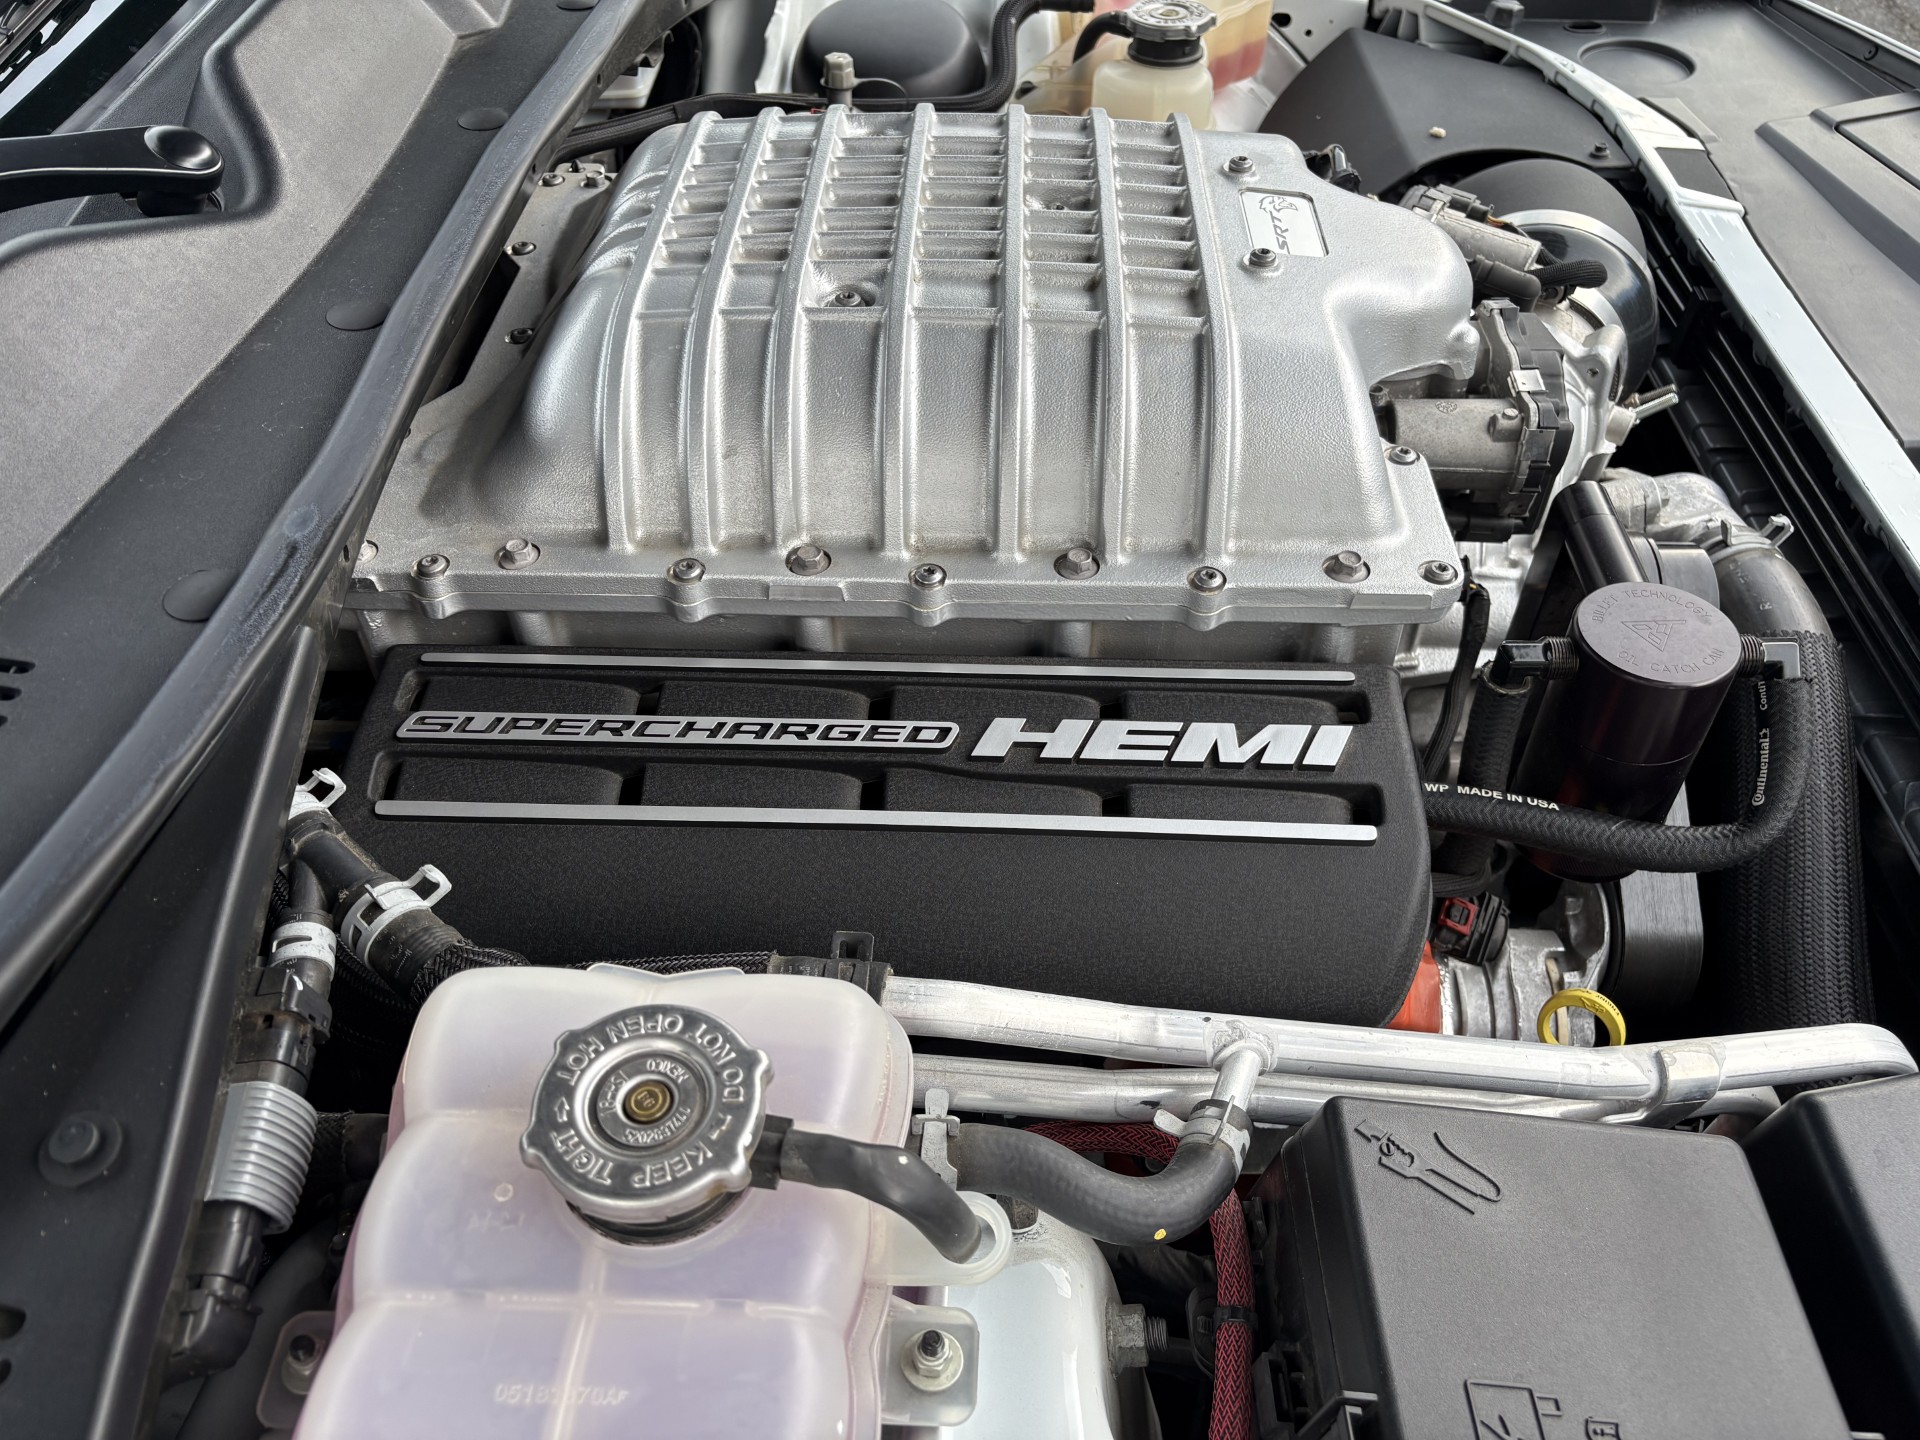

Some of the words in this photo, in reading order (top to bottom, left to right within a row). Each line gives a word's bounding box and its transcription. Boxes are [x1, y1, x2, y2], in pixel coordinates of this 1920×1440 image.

[1268, 210, 1290, 255] SRT
[1592, 594, 1619, 624] BILLET
[1625, 589, 1713, 619] TECHNOLOGY
[1617, 650, 1639, 666] OIL
[1651, 661, 1701, 675] CATCH
[1702, 648, 1726, 666] CAN
[404, 716, 954, 743] SUPERCHARGED
[970, 717, 1354, 768] HEMI
[1752, 738, 1769, 806] Continental
[1424, 783, 1449, 792] WP
[1457, 786, 1503, 799] MADE
[1507, 793, 1523, 803] IN
[1527, 797, 1560, 811] USA
[606, 1013, 685, 1043] OPEN
[694, 1022, 737, 1066] NOT
[556, 1036, 606, 1087] HOT
[646, 1059, 689, 1084] MEXICO
[722, 1066, 745, 1103] DO
[550, 1129, 613, 1186] TIGHT
[631, 1140, 713, 1188] KEEP
